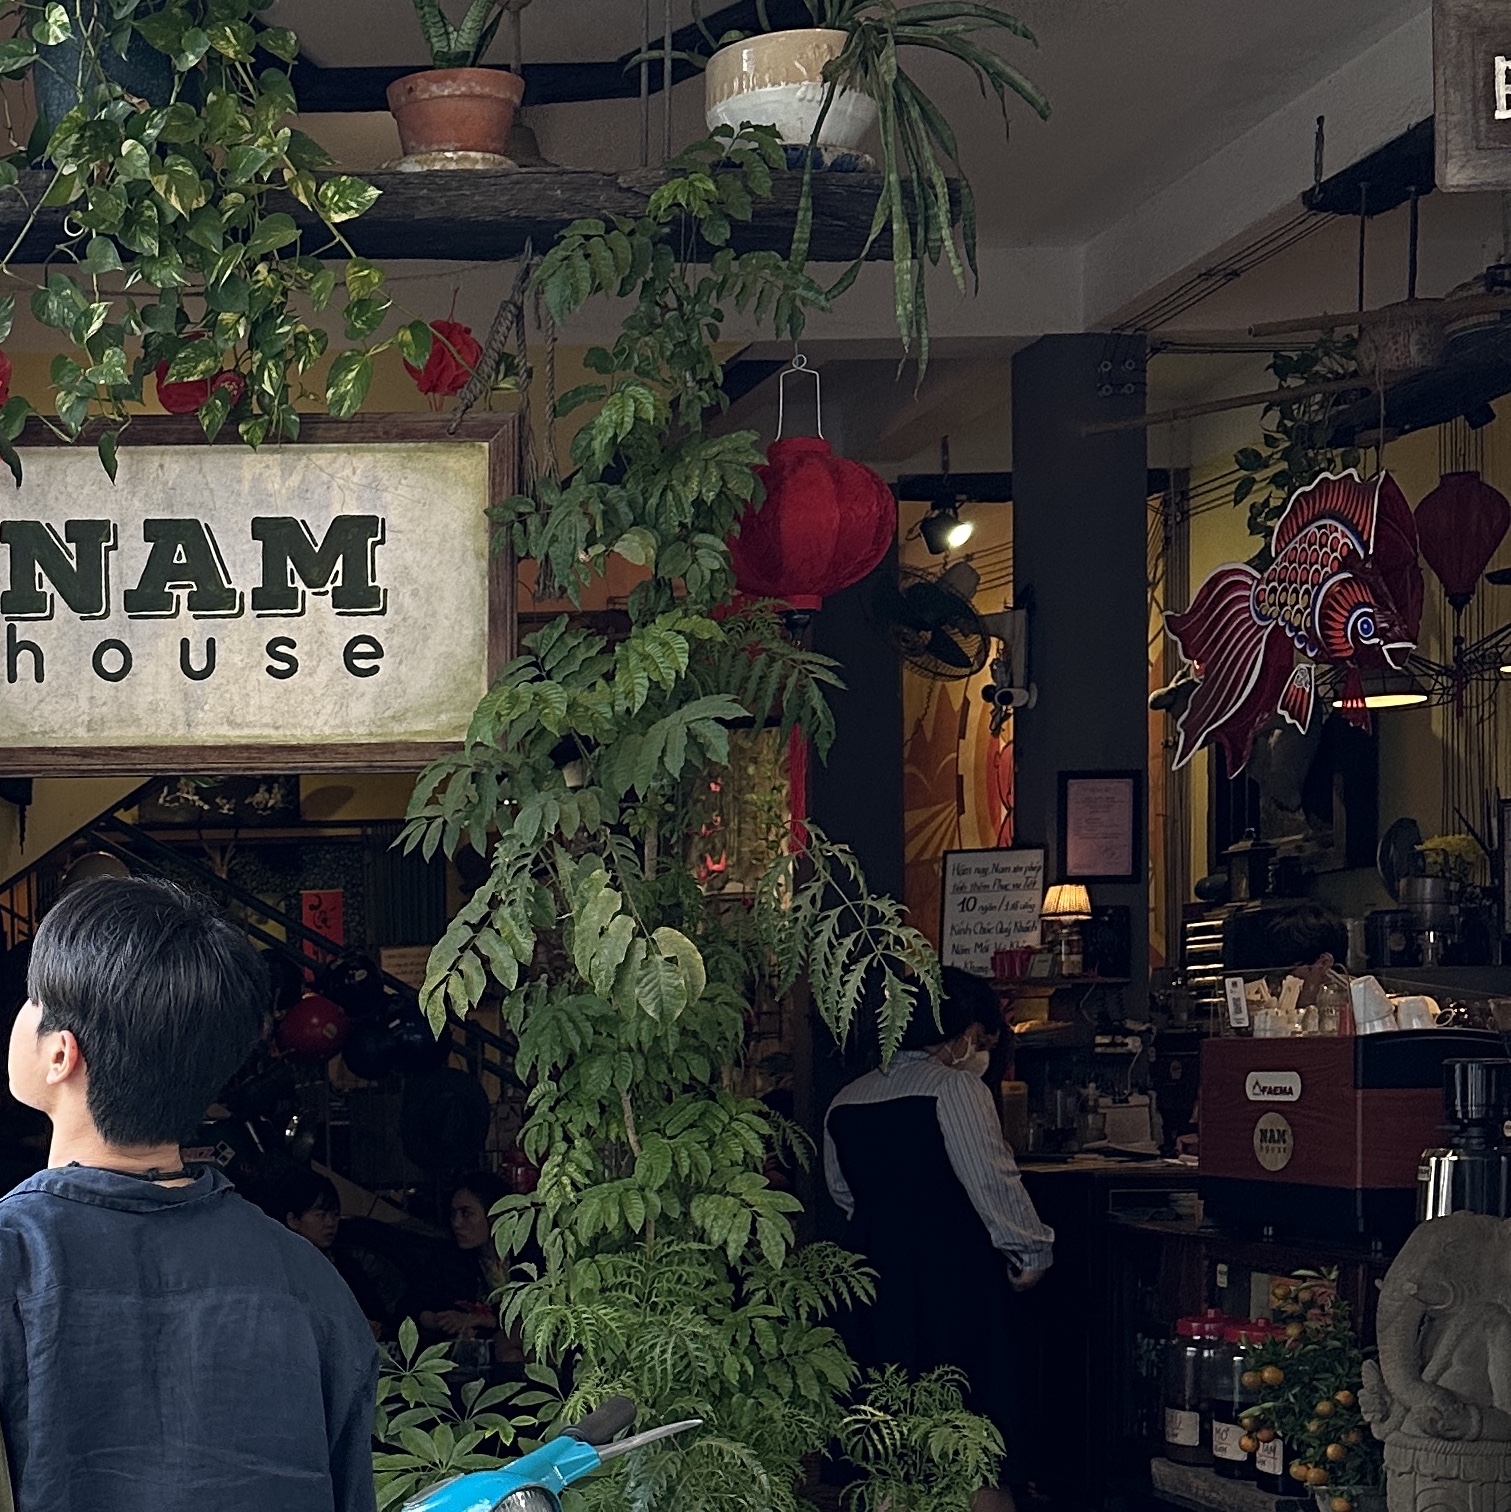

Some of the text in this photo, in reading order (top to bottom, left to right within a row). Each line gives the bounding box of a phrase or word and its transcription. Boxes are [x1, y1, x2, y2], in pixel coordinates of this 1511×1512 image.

[0, 514, 387, 622] NAM
[6, 622, 385, 684] house
[957, 896, 978, 913] 10
[1261, 1085, 1294, 1096] FAEMA
[1259, 1129, 1287, 1144] NAM
